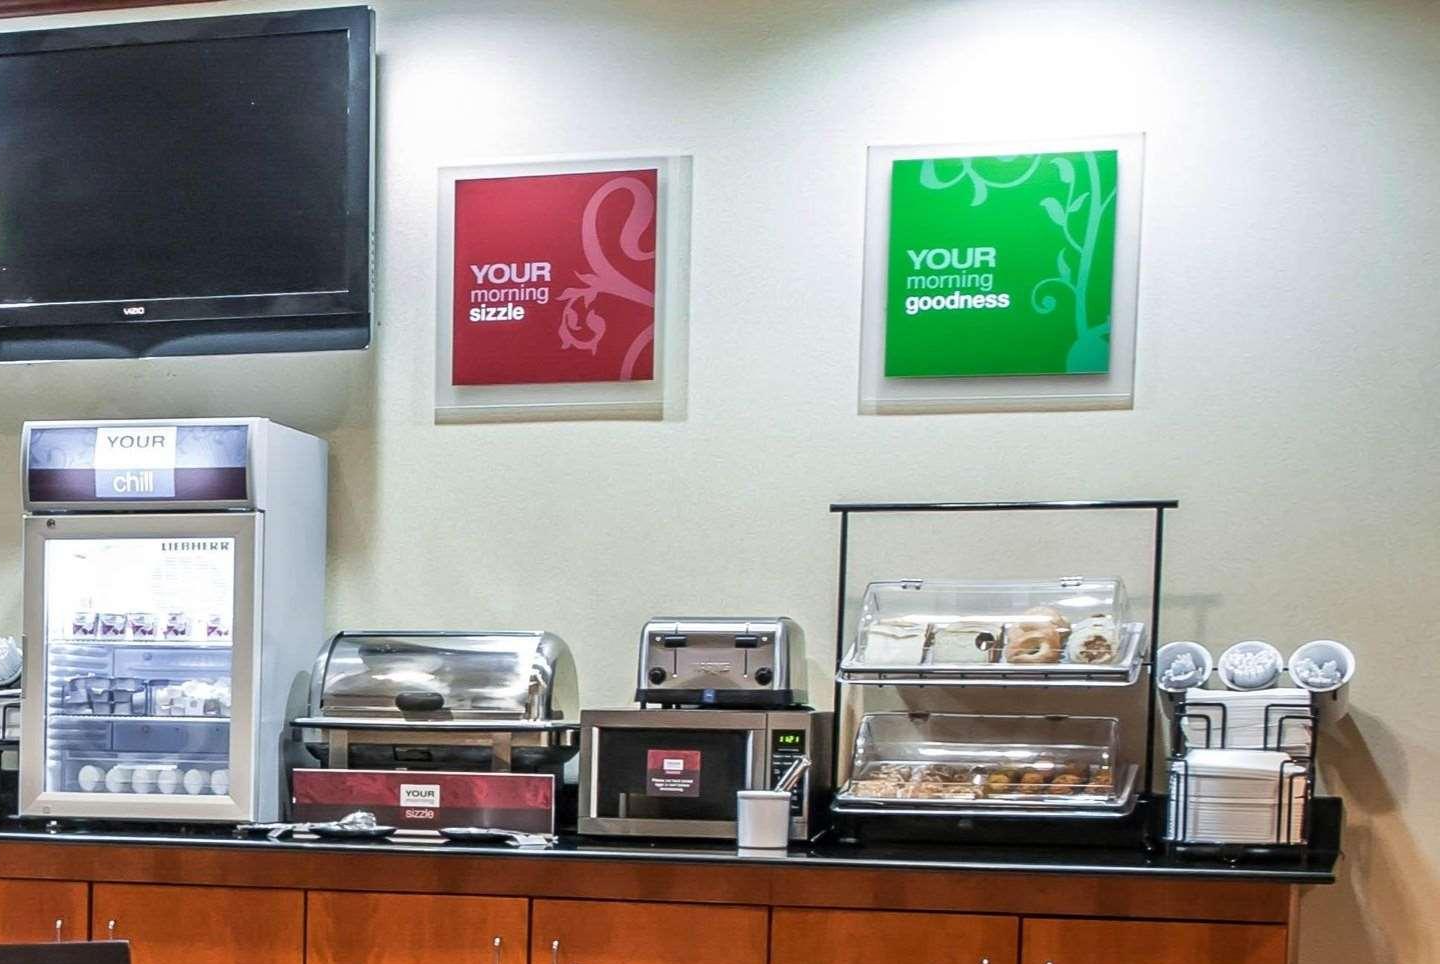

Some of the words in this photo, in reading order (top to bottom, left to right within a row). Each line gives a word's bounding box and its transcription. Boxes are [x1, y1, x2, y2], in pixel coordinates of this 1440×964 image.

[907, 247, 996, 270] YOUR
[470, 262, 551, 284] YOUR
[907, 270, 993, 291] morning
[471, 284, 549, 304] morning
[905, 291, 1010, 315] goodness
[469, 303, 525, 322] sizzle
[107, 435, 165, 448] YOUR
[113, 471, 154, 493] chill
[405, 808, 435, 819] sizzle
